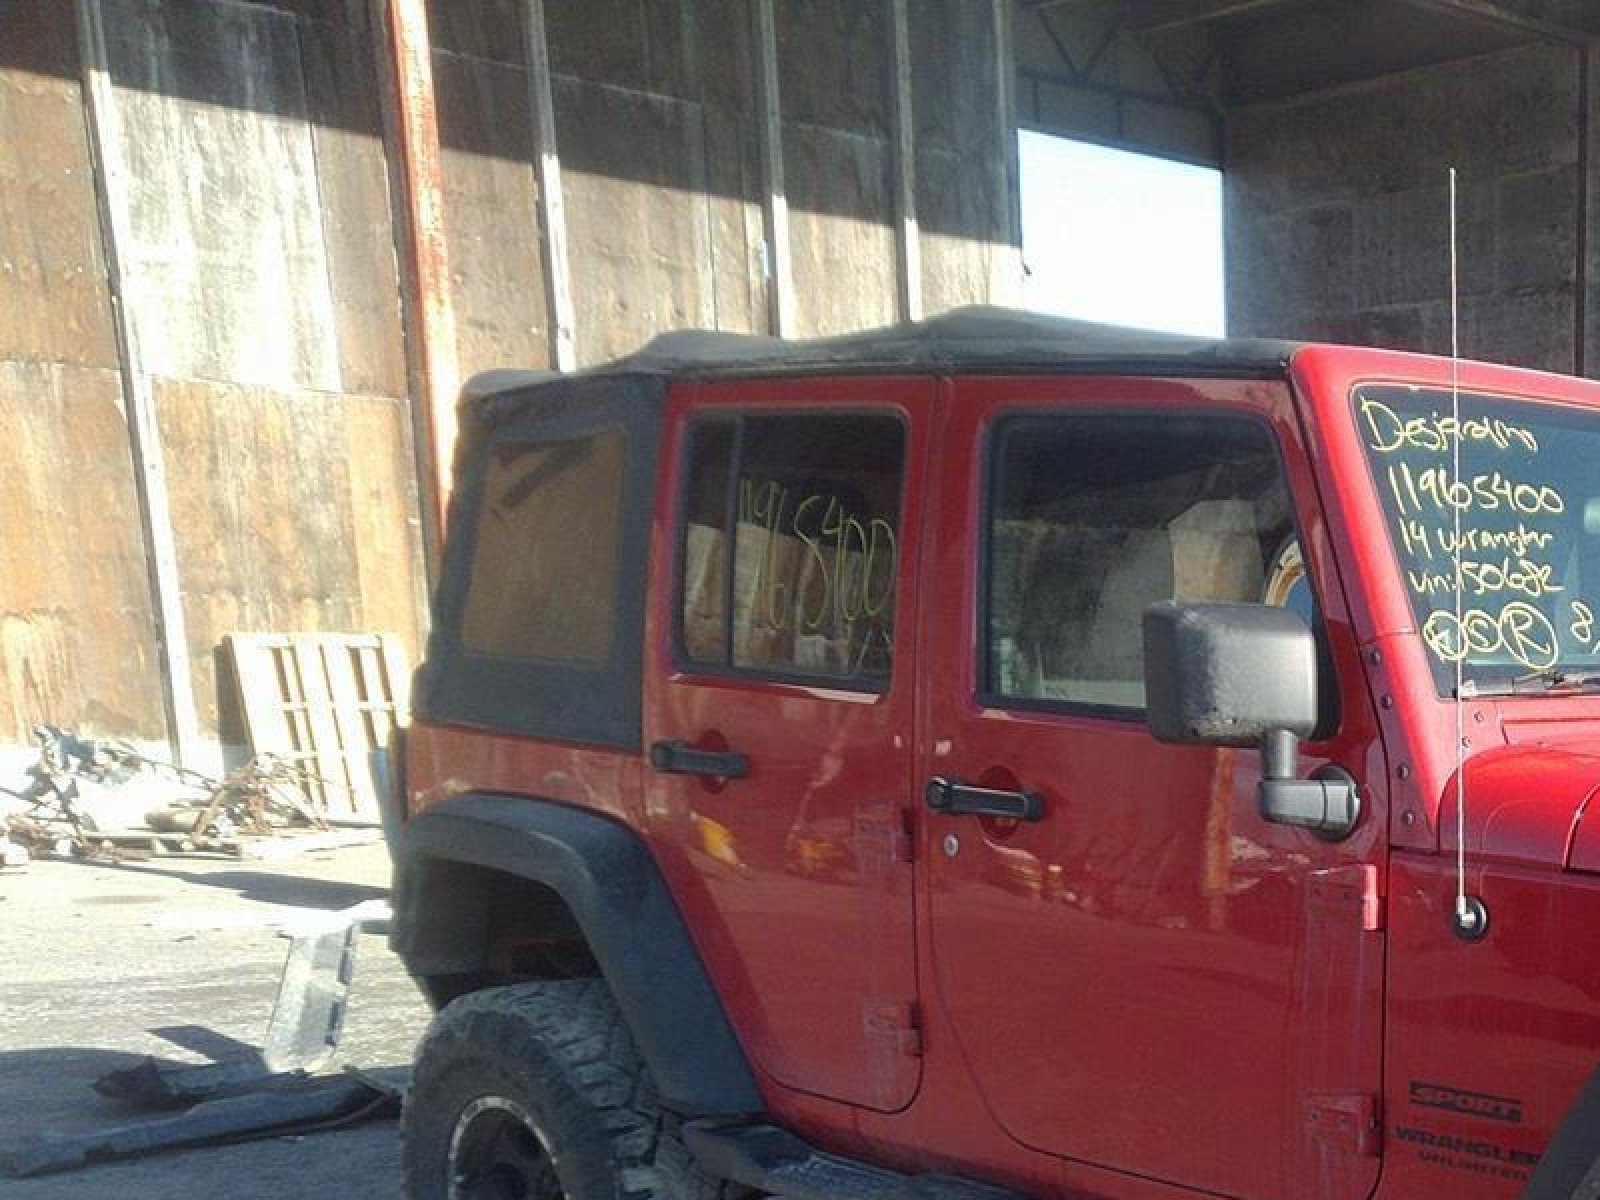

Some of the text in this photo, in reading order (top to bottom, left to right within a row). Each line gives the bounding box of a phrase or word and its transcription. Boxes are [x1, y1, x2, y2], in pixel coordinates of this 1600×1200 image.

[1387, 461, 1565, 514] 11965400
[1398, 516, 1433, 559] 14
[1411, 1086, 1512, 1118] SPORT
